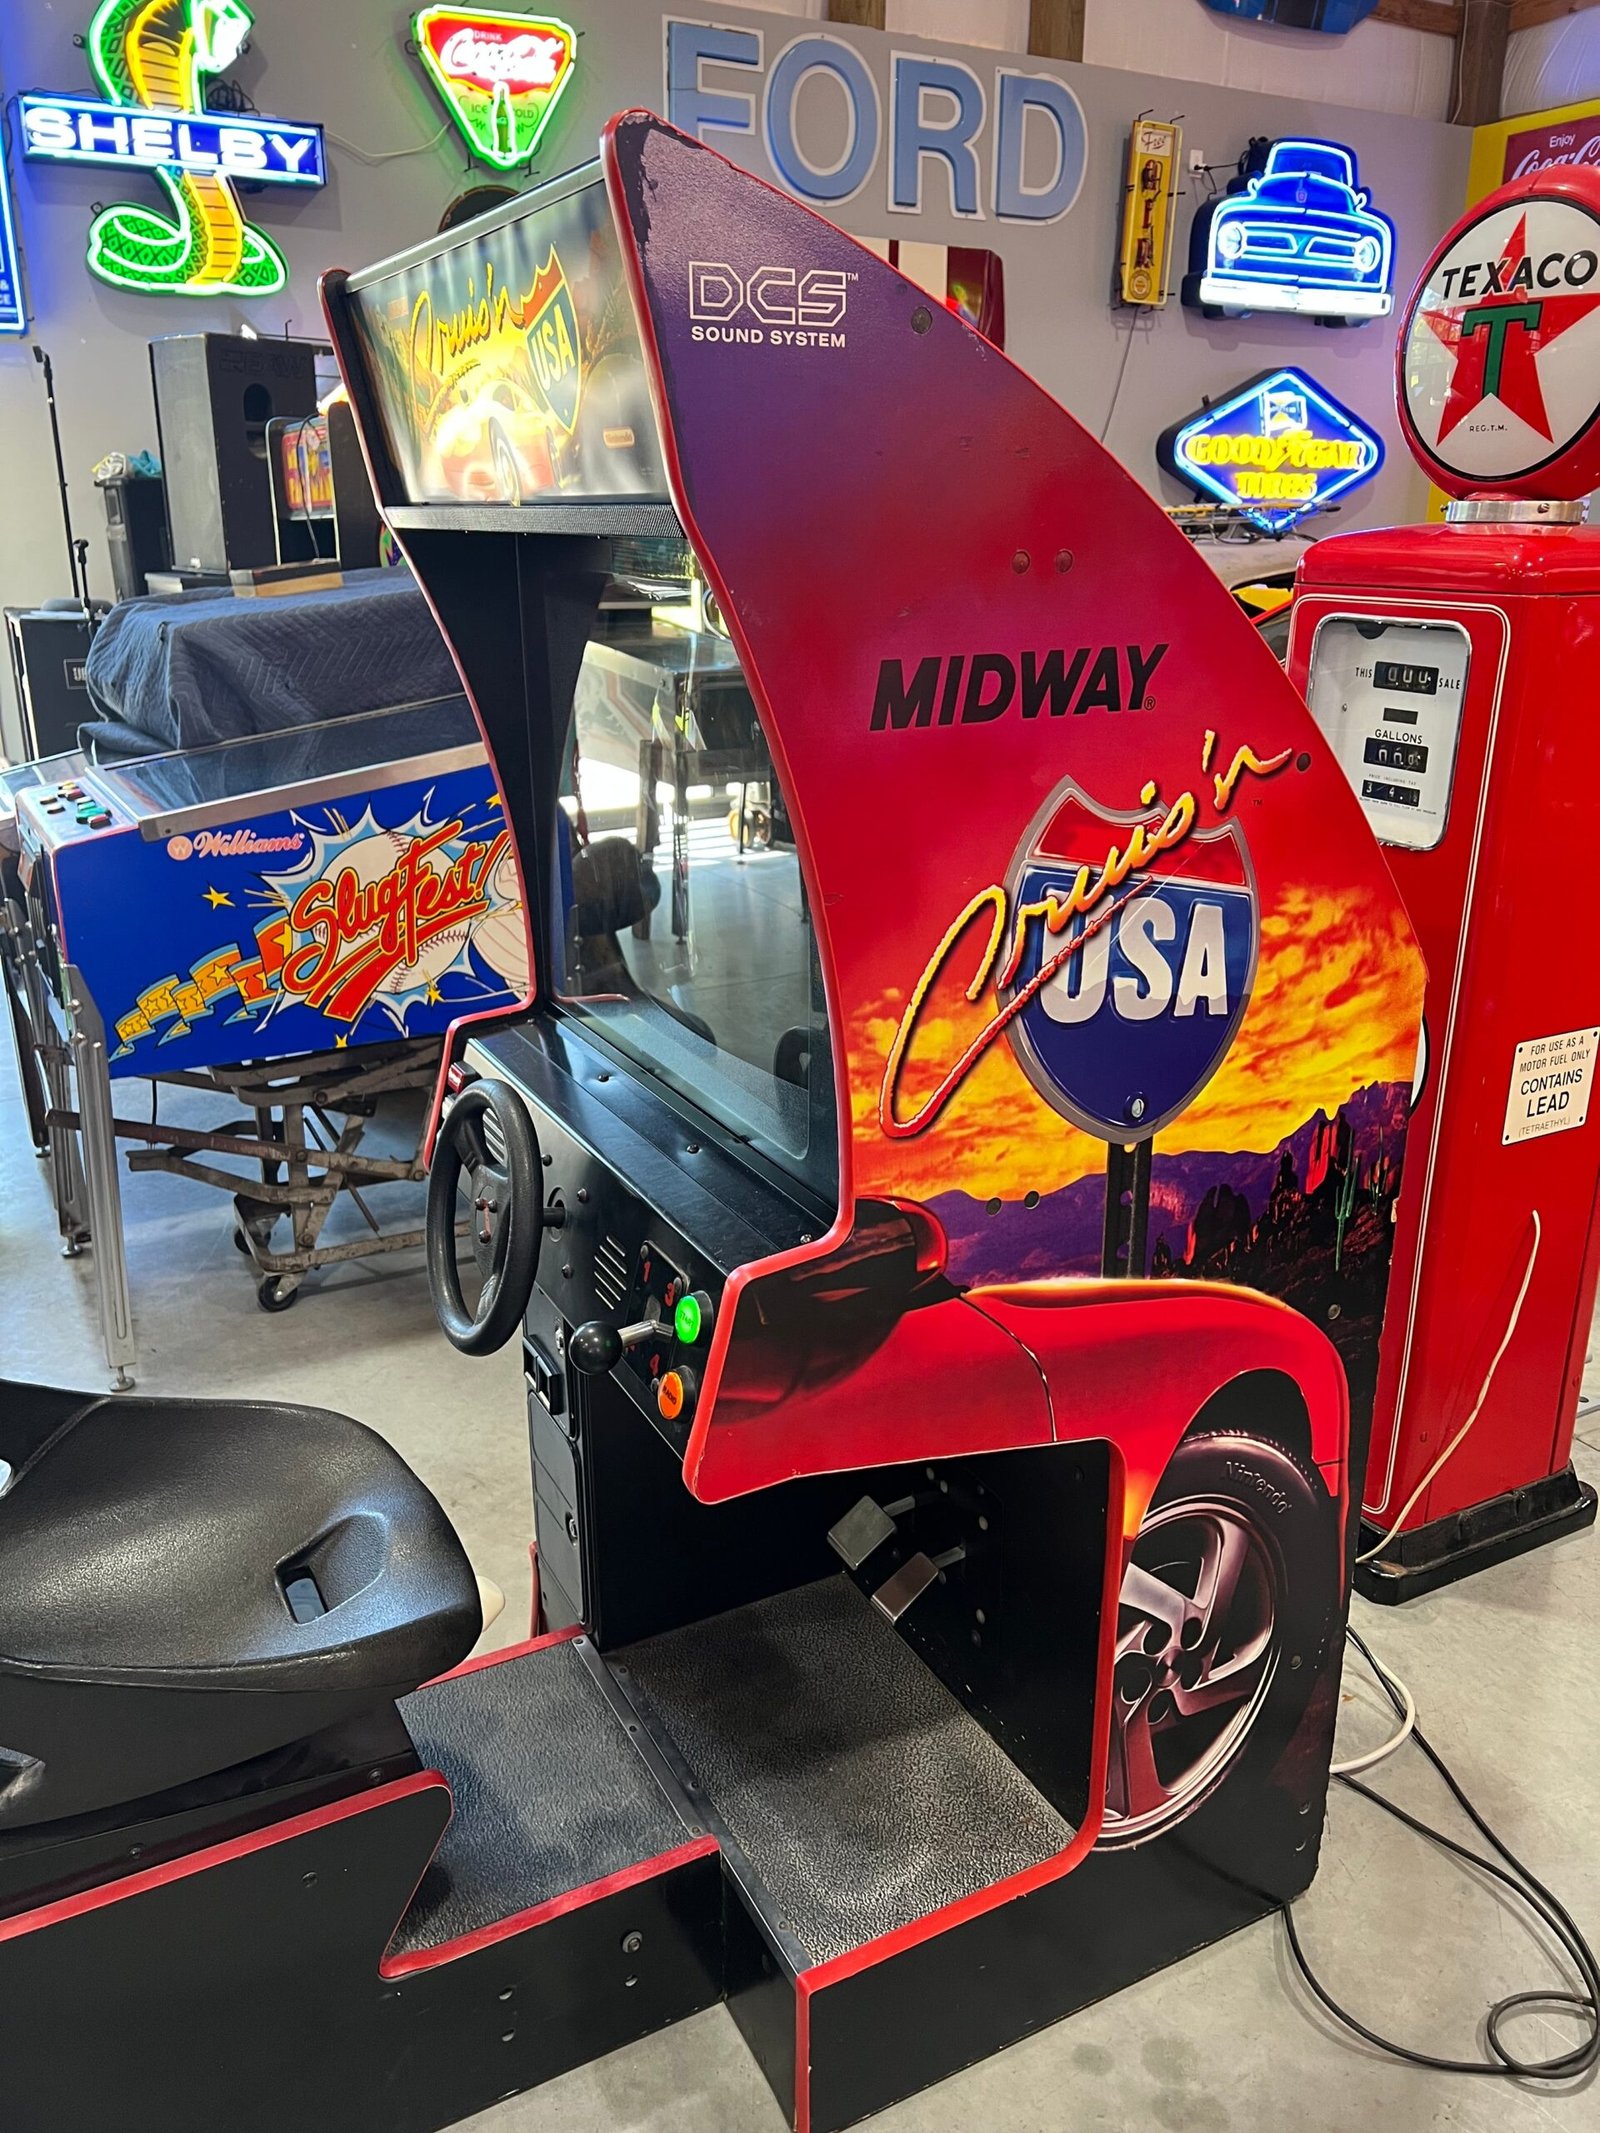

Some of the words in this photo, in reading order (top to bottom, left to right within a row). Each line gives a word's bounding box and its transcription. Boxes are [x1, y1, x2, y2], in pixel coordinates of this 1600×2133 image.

[471, 104, 488, 114] ICE
[513, 107, 534, 119] OLD
[662, 14, 1089, 226] FORD
[25, 107, 313, 173] SHELBY
[1549, 134, 1576, 149] Enjoy
[1442, 249, 1599, 301] TEXACO
[688, 260, 847, 327] DCS
[530, 304, 577, 392] USA
[691, 325, 764, 345] SOUND
[769, 329, 847, 348] SYSTEM
[869, 643, 1169, 732] MIDWAY
[1355, 667, 1373, 679] THIS
[1438, 677, 1461, 690] SALE
[1374, 729, 1423, 744] GALLONS
[879, 728, 1293, 1138] Cruis'n
[1040, 885, 1229, 1024] USA
[1531, 1043, 1546, 1056] FOR
[1548, 1039, 1564, 1052] USE
[1566, 1037, 1577, 1048] AS
[1579, 1035, 1584, 1045] A
[1520, 1058, 1547, 1073] MOTOR
[1549, 1054, 1568, 1067] FUEL
[1571, 1048, 1591, 1062] ONLY
[1521, 1068, 1583, 1096] CONTAINS
[1526, 1091, 1570, 1118] LEAD
